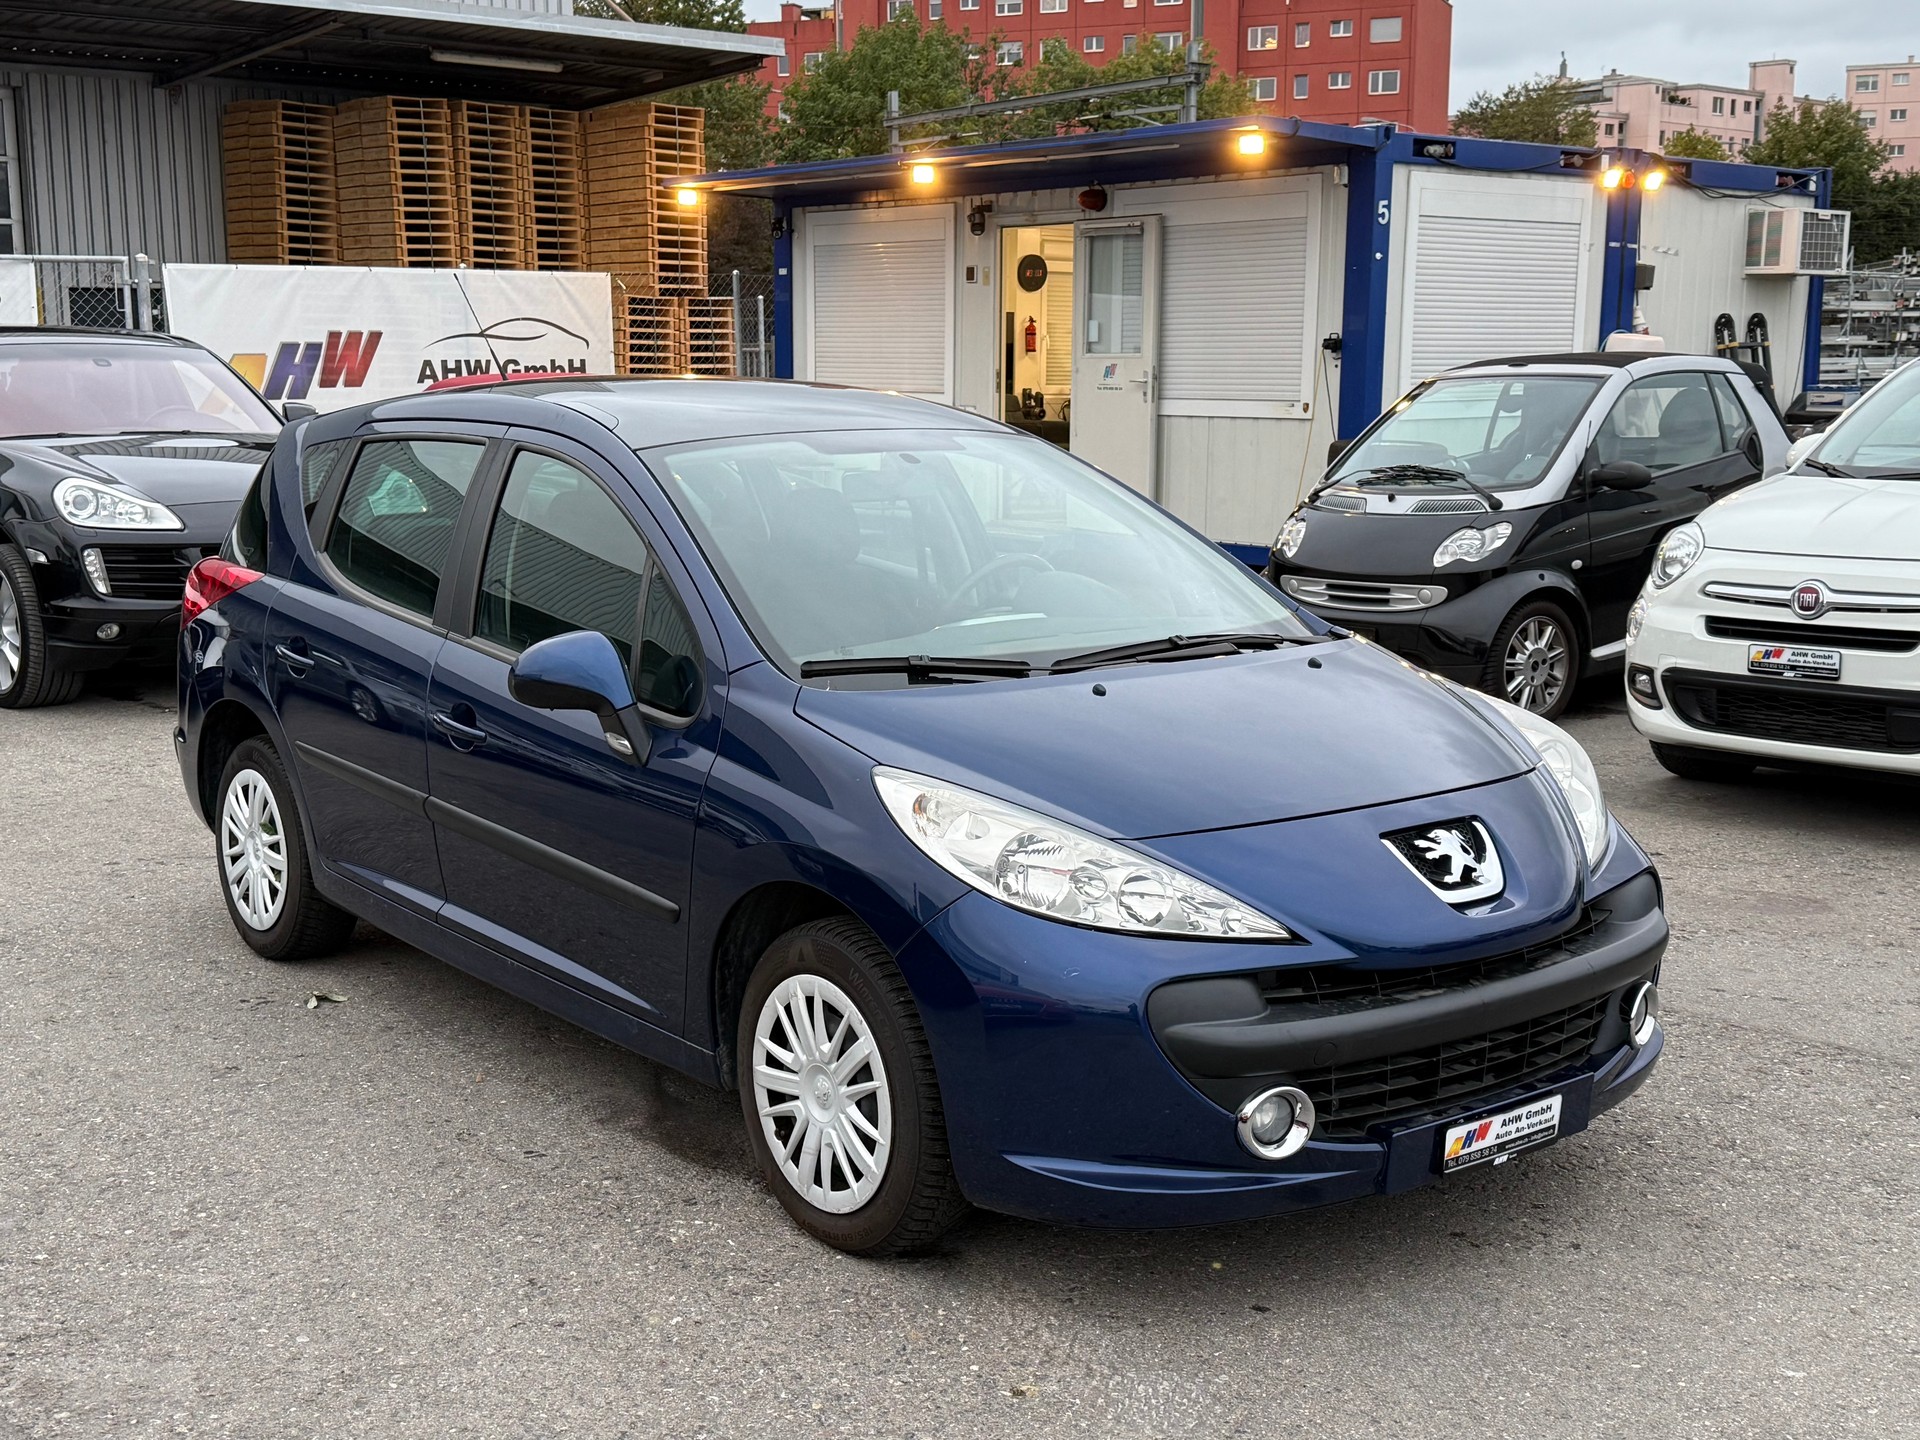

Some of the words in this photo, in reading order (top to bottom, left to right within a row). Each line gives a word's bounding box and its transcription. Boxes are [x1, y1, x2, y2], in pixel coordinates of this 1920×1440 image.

[1377, 199, 1389, 225] 5
[417, 358, 492, 383] AHW
[1799, 593, 1818, 607] FIAT
[1751, 647, 1785, 661] AHW
[1802, 659, 1837, 667] An-Verkauf
[1810, 652, 1834, 660] GmbH
[1500, 1113, 1524, 1129] AHW
[1525, 1103, 1553, 1120] GmbH
[1446, 1119, 1494, 1159] AHW
[1494, 1130, 1513, 1141] Auto
[1513, 1115, 1555, 1134] An-Verkauf
[1458, 1155, 1470, 1165] 079
[1470, 1151, 1482, 1161] 858
[1481, 1148, 1490, 1157] 58
[1490, 1145, 1498, 1154] 24
